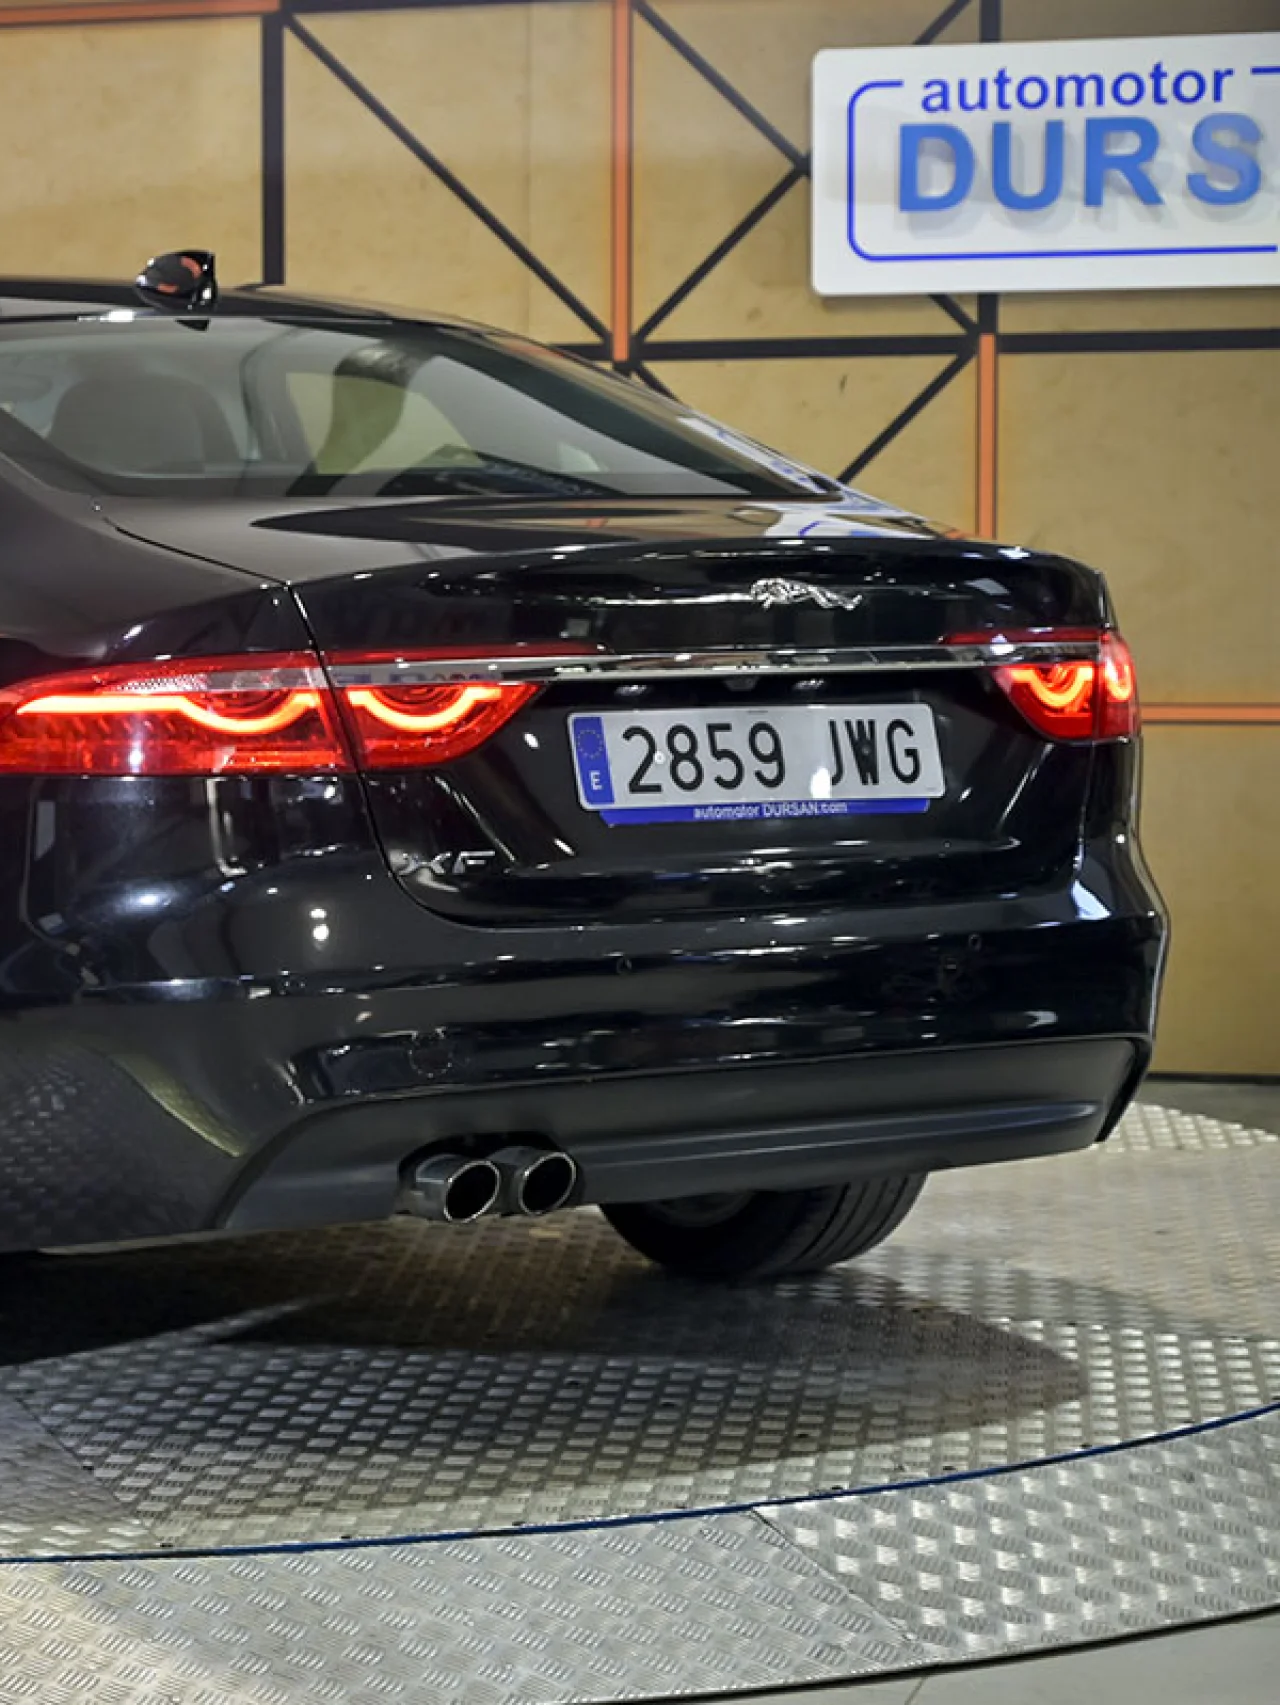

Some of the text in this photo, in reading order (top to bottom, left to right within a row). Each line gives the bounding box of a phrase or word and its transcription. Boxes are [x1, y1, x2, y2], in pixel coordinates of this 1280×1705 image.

[921, 62, 1234, 113] automotor
[898, 112, 1262, 213] DURS
[622, 719, 922, 794] 2859 JWG
[590, 770, 602, 790] E
[693, 803, 759, 819] automotor
[399, 851, 495, 875] XF
